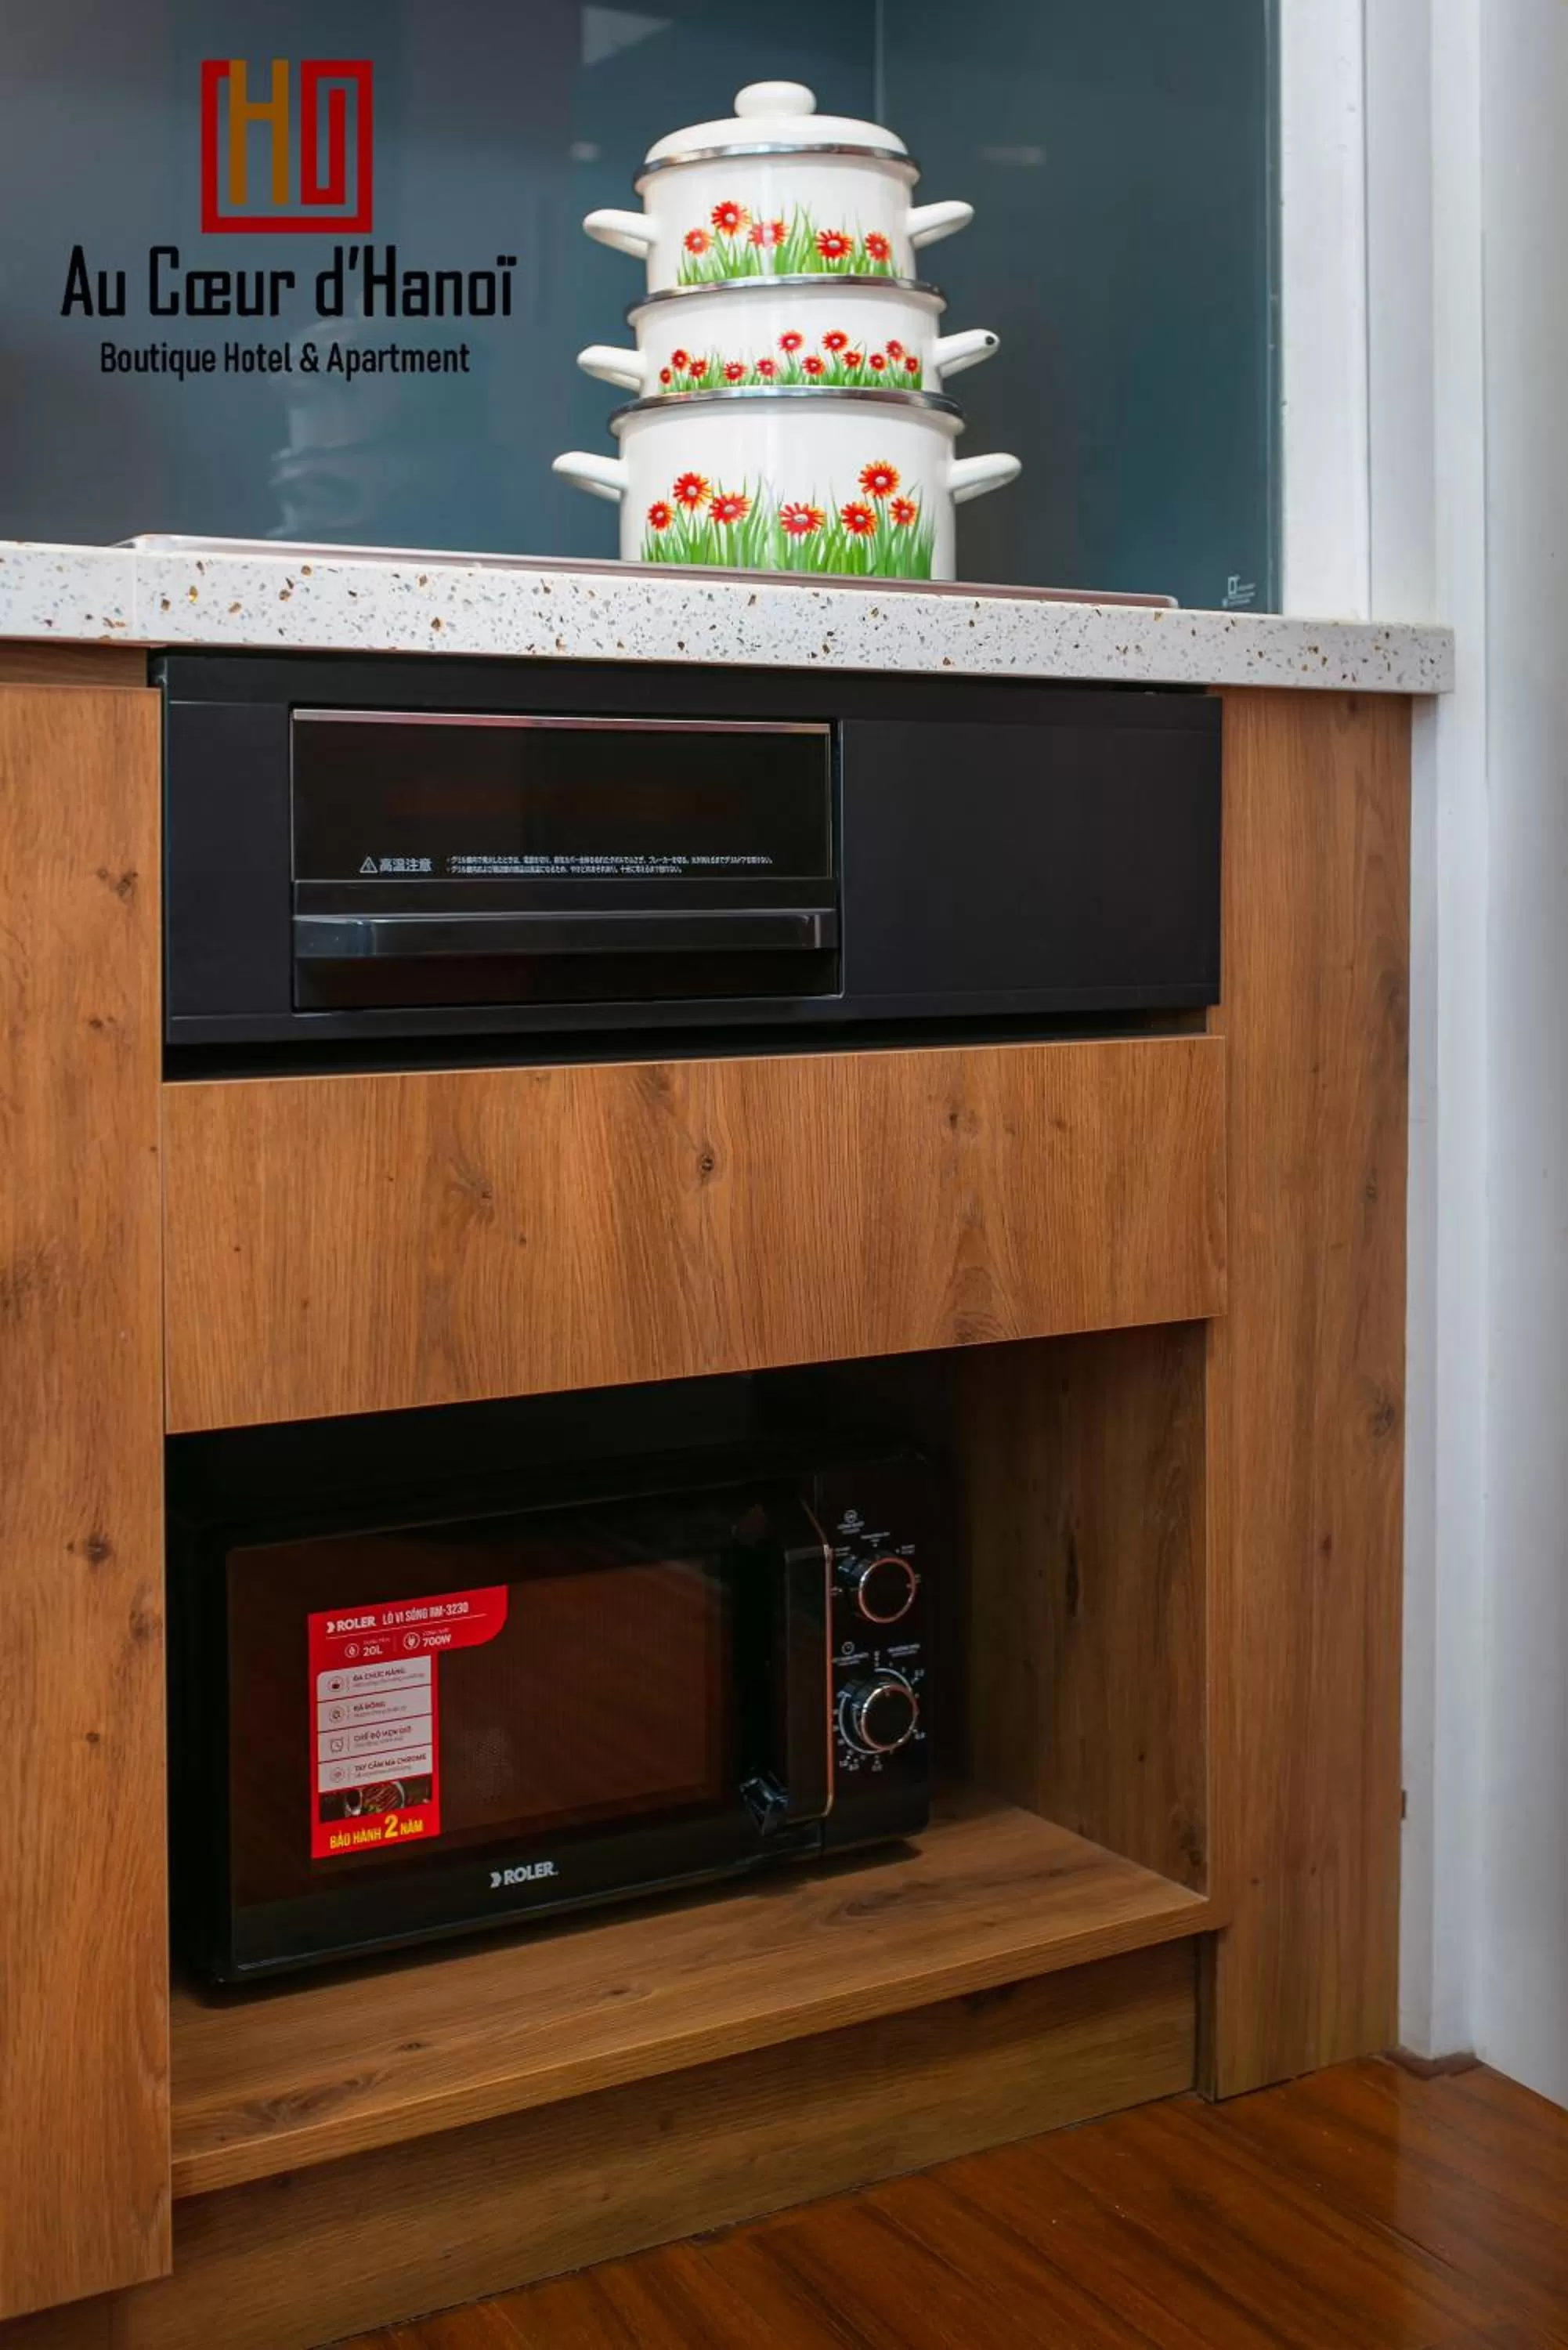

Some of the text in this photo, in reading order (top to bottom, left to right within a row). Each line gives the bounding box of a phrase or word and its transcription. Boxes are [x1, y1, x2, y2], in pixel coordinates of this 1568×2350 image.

[337, 1615, 376, 1632] ROLER
[423, 1634, 452, 1647] 700W
[363, 1644, 383, 1657] 20L
[385, 1813, 399, 1838] 2
[503, 1860, 555, 1885] ROLER
